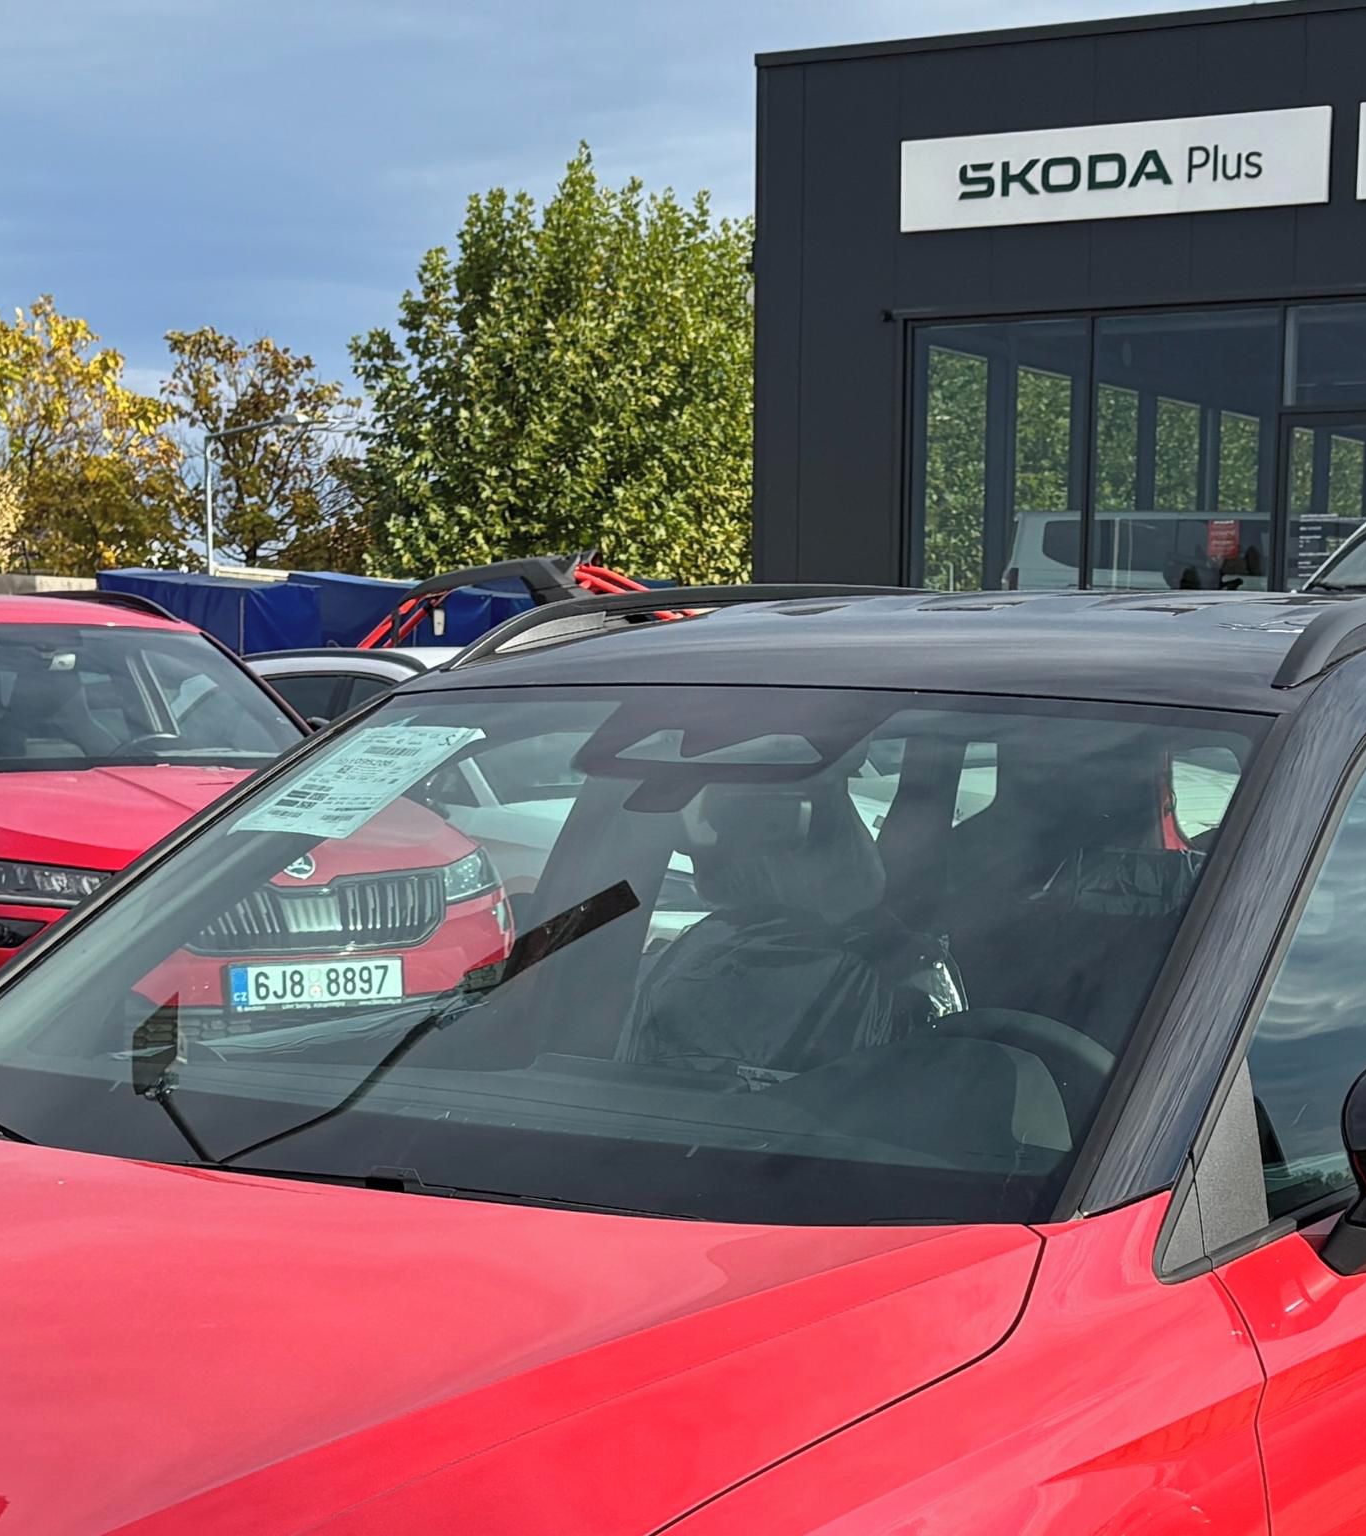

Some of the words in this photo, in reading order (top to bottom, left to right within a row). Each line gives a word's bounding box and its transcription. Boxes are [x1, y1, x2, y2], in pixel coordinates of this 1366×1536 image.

[1186, 144, 1264, 184] Plus
[233, 991, 248, 1002] CZ
[254, 969, 305, 1001] 6J8
[326, 964, 389, 998] 8897
